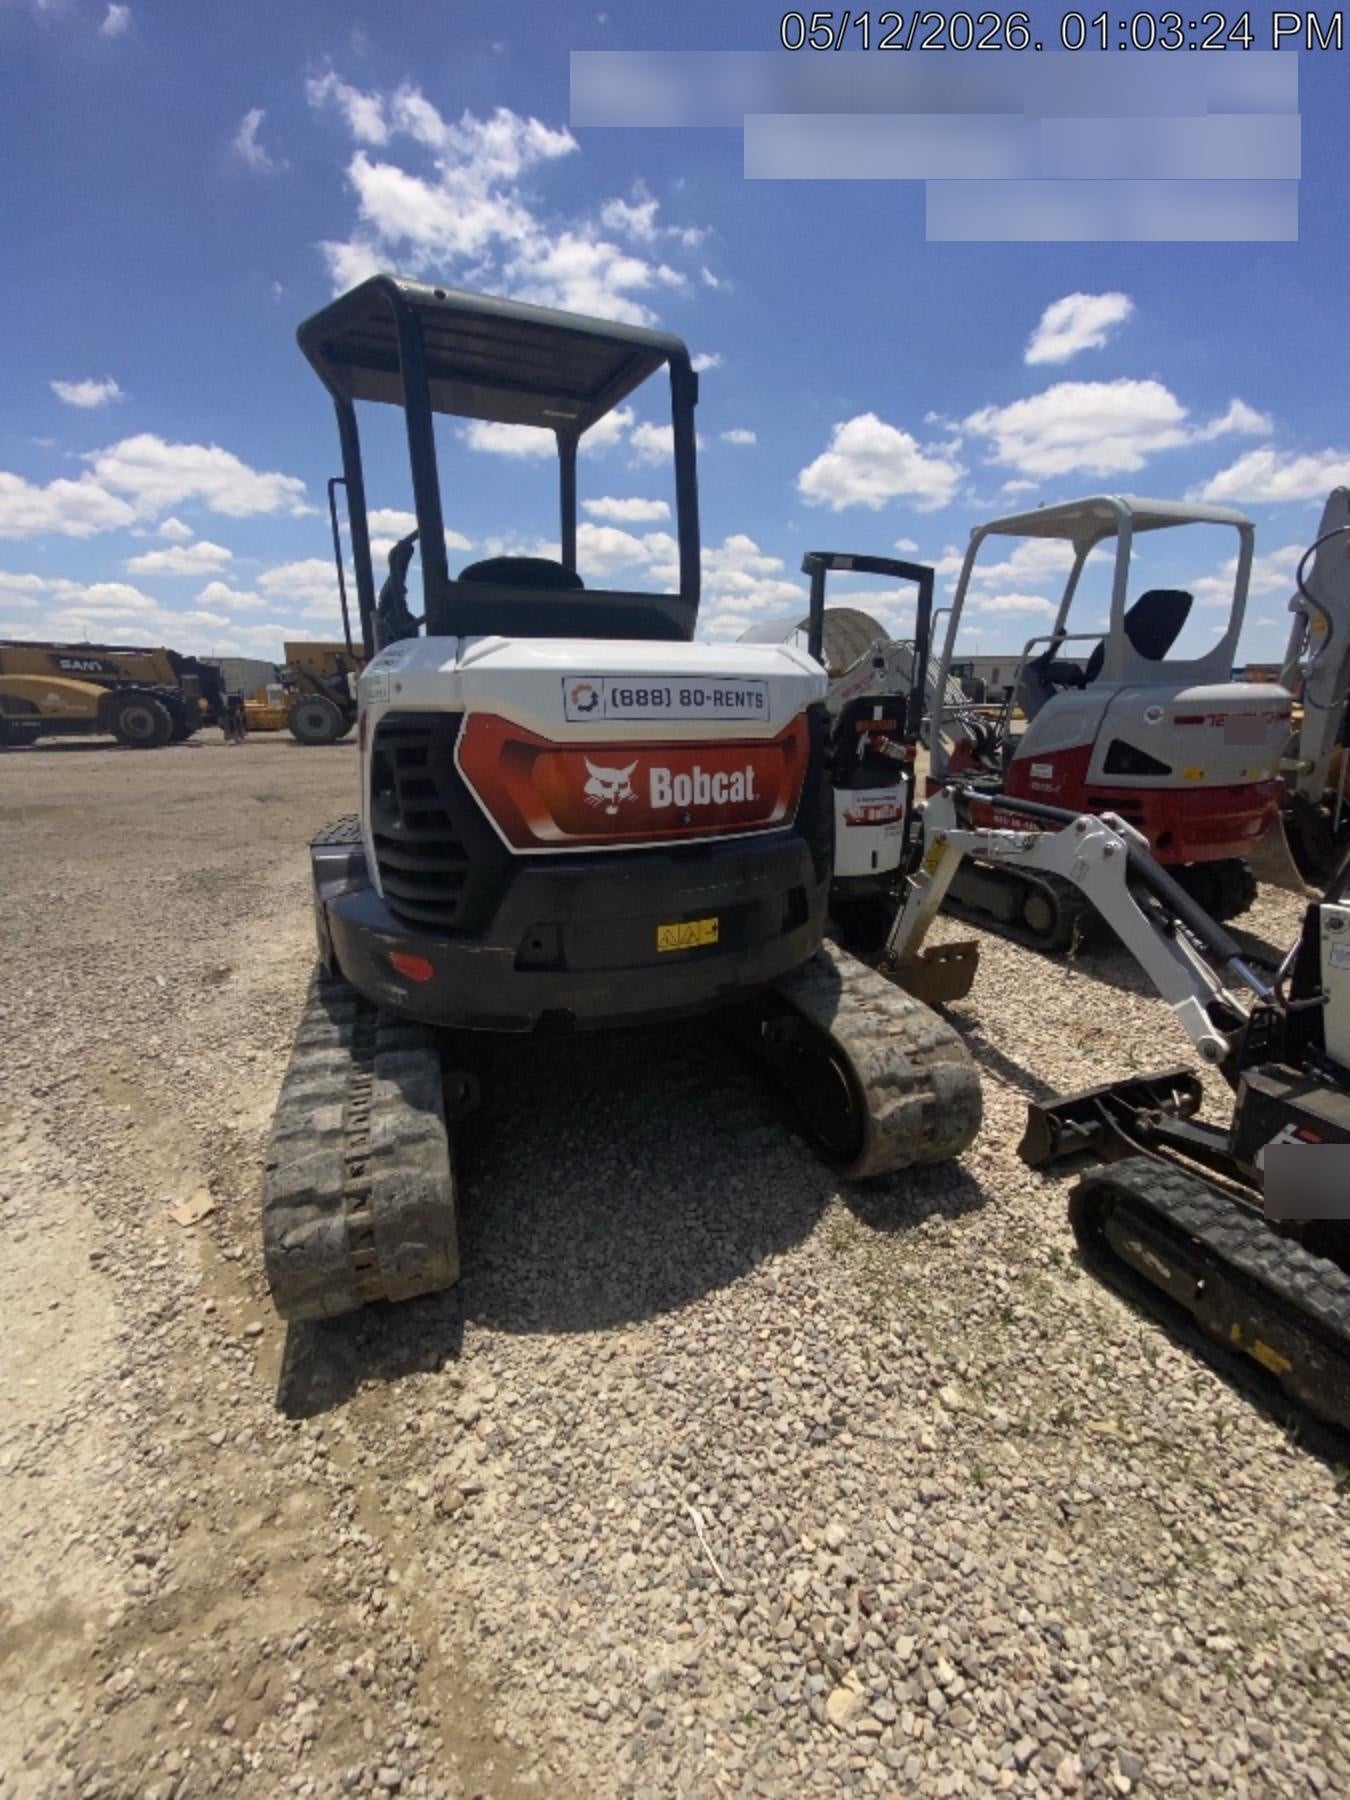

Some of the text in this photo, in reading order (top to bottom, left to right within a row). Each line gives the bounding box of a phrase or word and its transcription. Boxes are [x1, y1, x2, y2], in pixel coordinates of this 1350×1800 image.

[611, 687, 764, 709] (888) 80-RENTS
[649, 765, 755, 809] Bobcat
